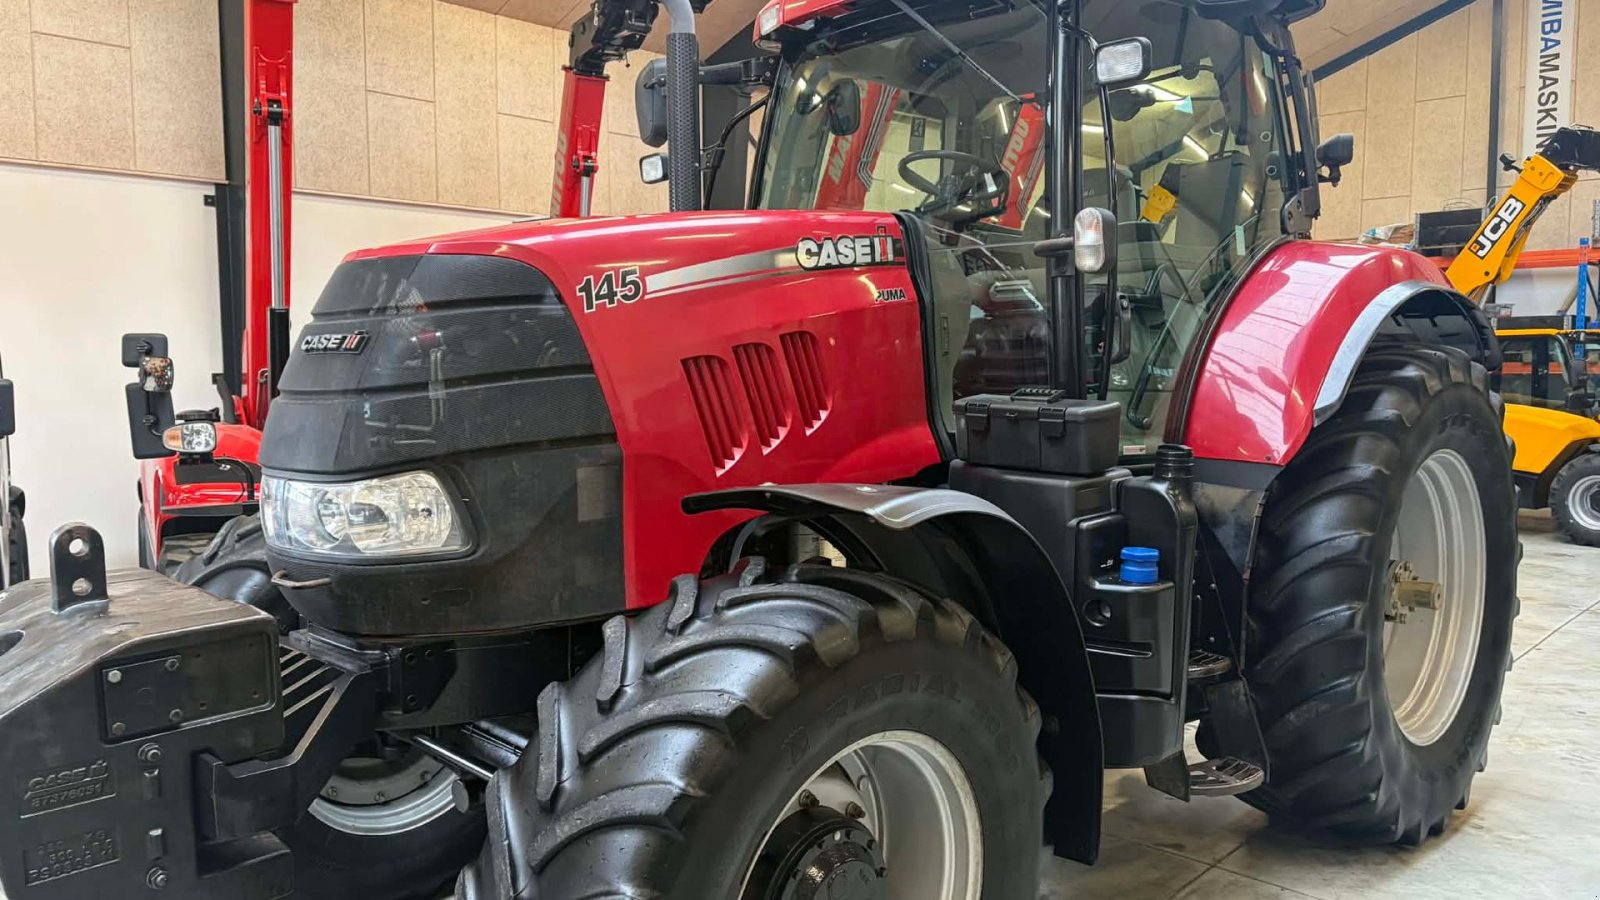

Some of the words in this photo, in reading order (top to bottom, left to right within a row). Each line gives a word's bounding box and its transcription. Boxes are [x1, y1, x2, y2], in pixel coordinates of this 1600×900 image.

[1477, 197, 1524, 257] JCB
[797, 236, 872, 270] CASE
[576, 266, 643, 313] 145
[875, 289, 906, 302] PUMA
[301, 334, 340, 351] CASE
